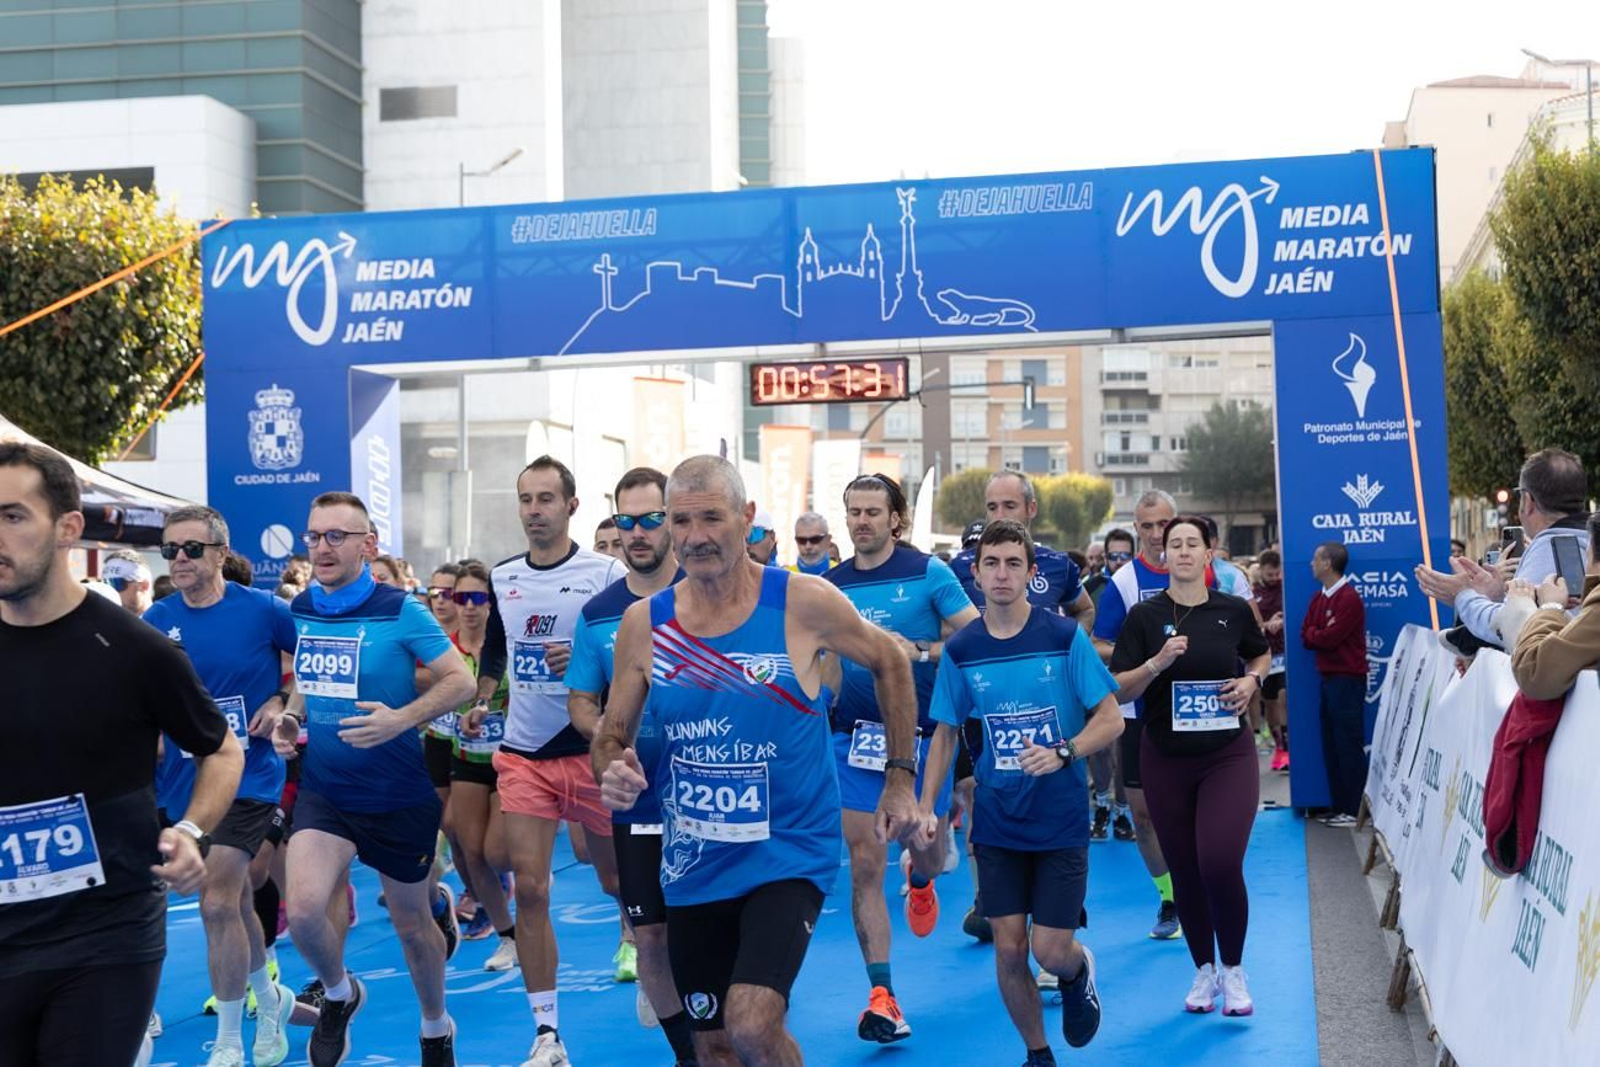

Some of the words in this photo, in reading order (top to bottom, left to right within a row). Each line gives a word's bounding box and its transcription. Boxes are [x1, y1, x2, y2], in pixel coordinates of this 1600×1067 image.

[938, 182, 1093, 218] #DEJAHUELLA
[511, 207, 657, 244] #DEJAHUELLA
[1280, 203, 1370, 229] MEDIA
[1273, 230, 1413, 262] MARATÓN
[355, 257, 435, 282] MEDIA
[1264, 267, 1334, 295] JAÉN
[350, 284, 472, 313] MARATÓN
[341, 318, 404, 343] JAÉN
[757, 364, 905, 401] 00:57:31
[1304, 422, 1354, 434] Patronato
[1355, 420, 1406, 433] Municipal
[1318, 433, 1366, 445] Deportes
[1367, 432, 1381, 442] de
[1384, 430, 1408, 441] Jaén
[234, 473, 276, 485] CIUDAD
[277, 473, 292, 484] DE
[293, 470, 320, 483] JAÉN
[1312, 513, 1353, 530] CAJA
[1358, 510, 1417, 526] RURAL
[1343, 527, 1385, 544] JAÉN
[1346, 571, 1408, 583] ACIA
[299, 653, 353, 675] 2099
[665, 717, 733, 742] RUNNING
[995, 723, 1054, 750] 2271
[678, 781, 761, 812] 2204
[0, 824, 84, 868] 179
[1512, 898, 1546, 973] JAÉN
